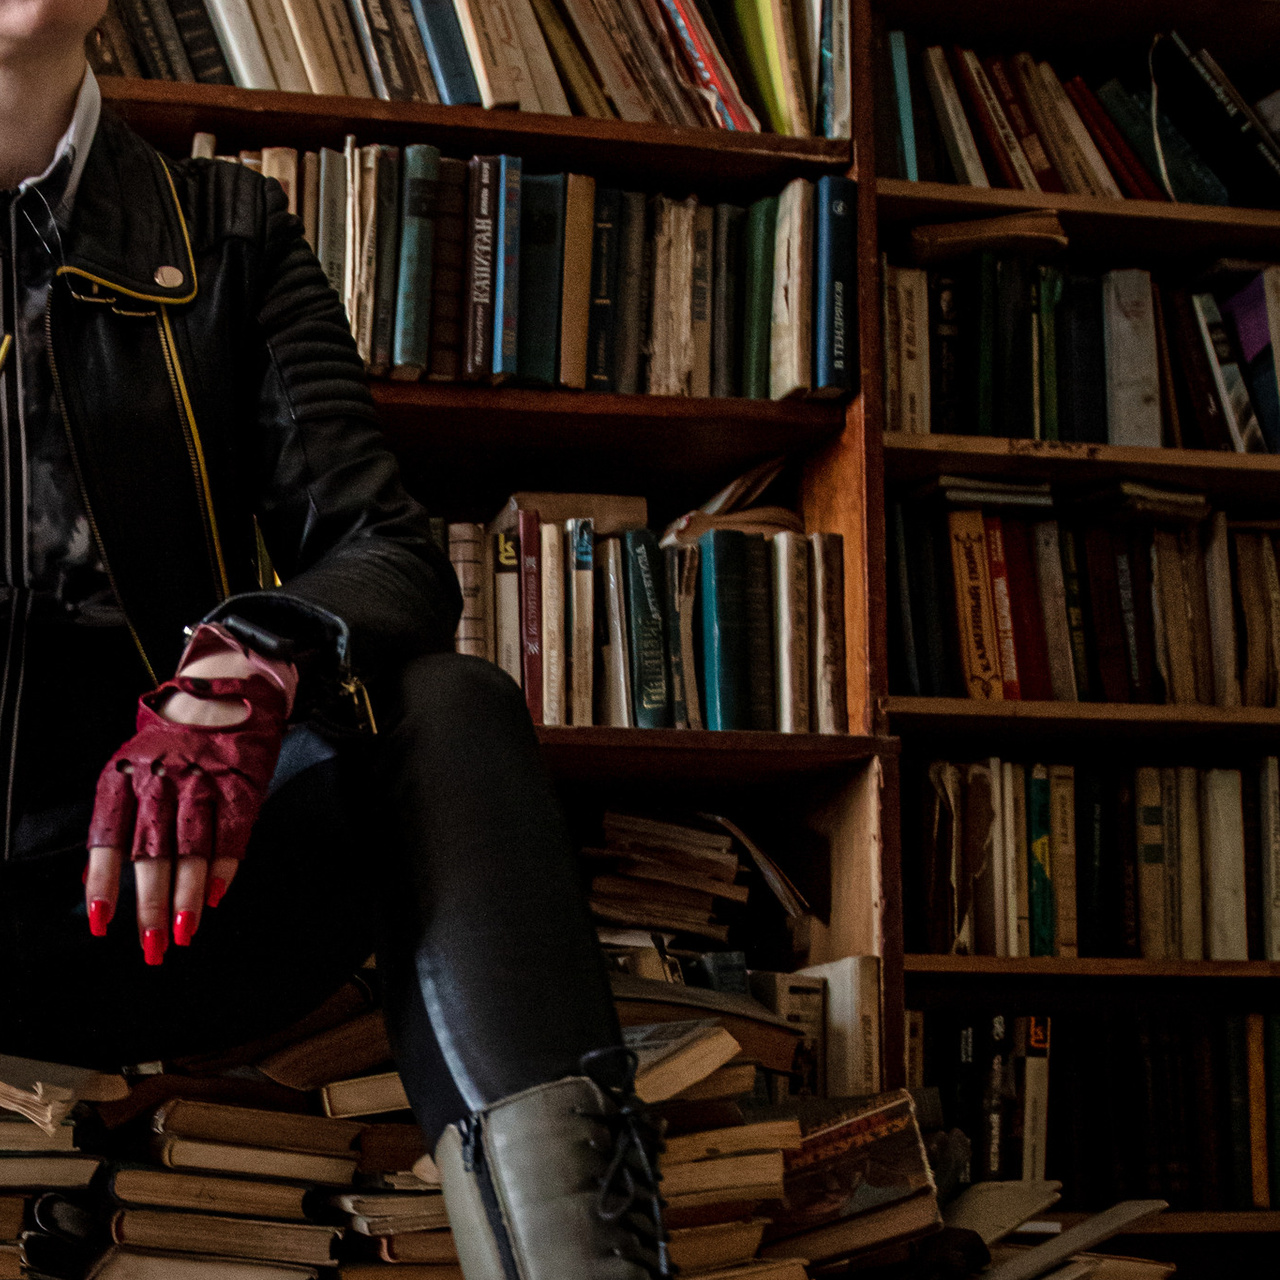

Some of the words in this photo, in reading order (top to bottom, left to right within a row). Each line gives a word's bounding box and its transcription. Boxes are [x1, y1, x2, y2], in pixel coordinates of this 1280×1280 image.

[467, 216, 495, 303] КАПИТАН
[964, 543, 978, 580] ПОЯС
[970, 585, 989, 672] КАМЕННЫЙ
